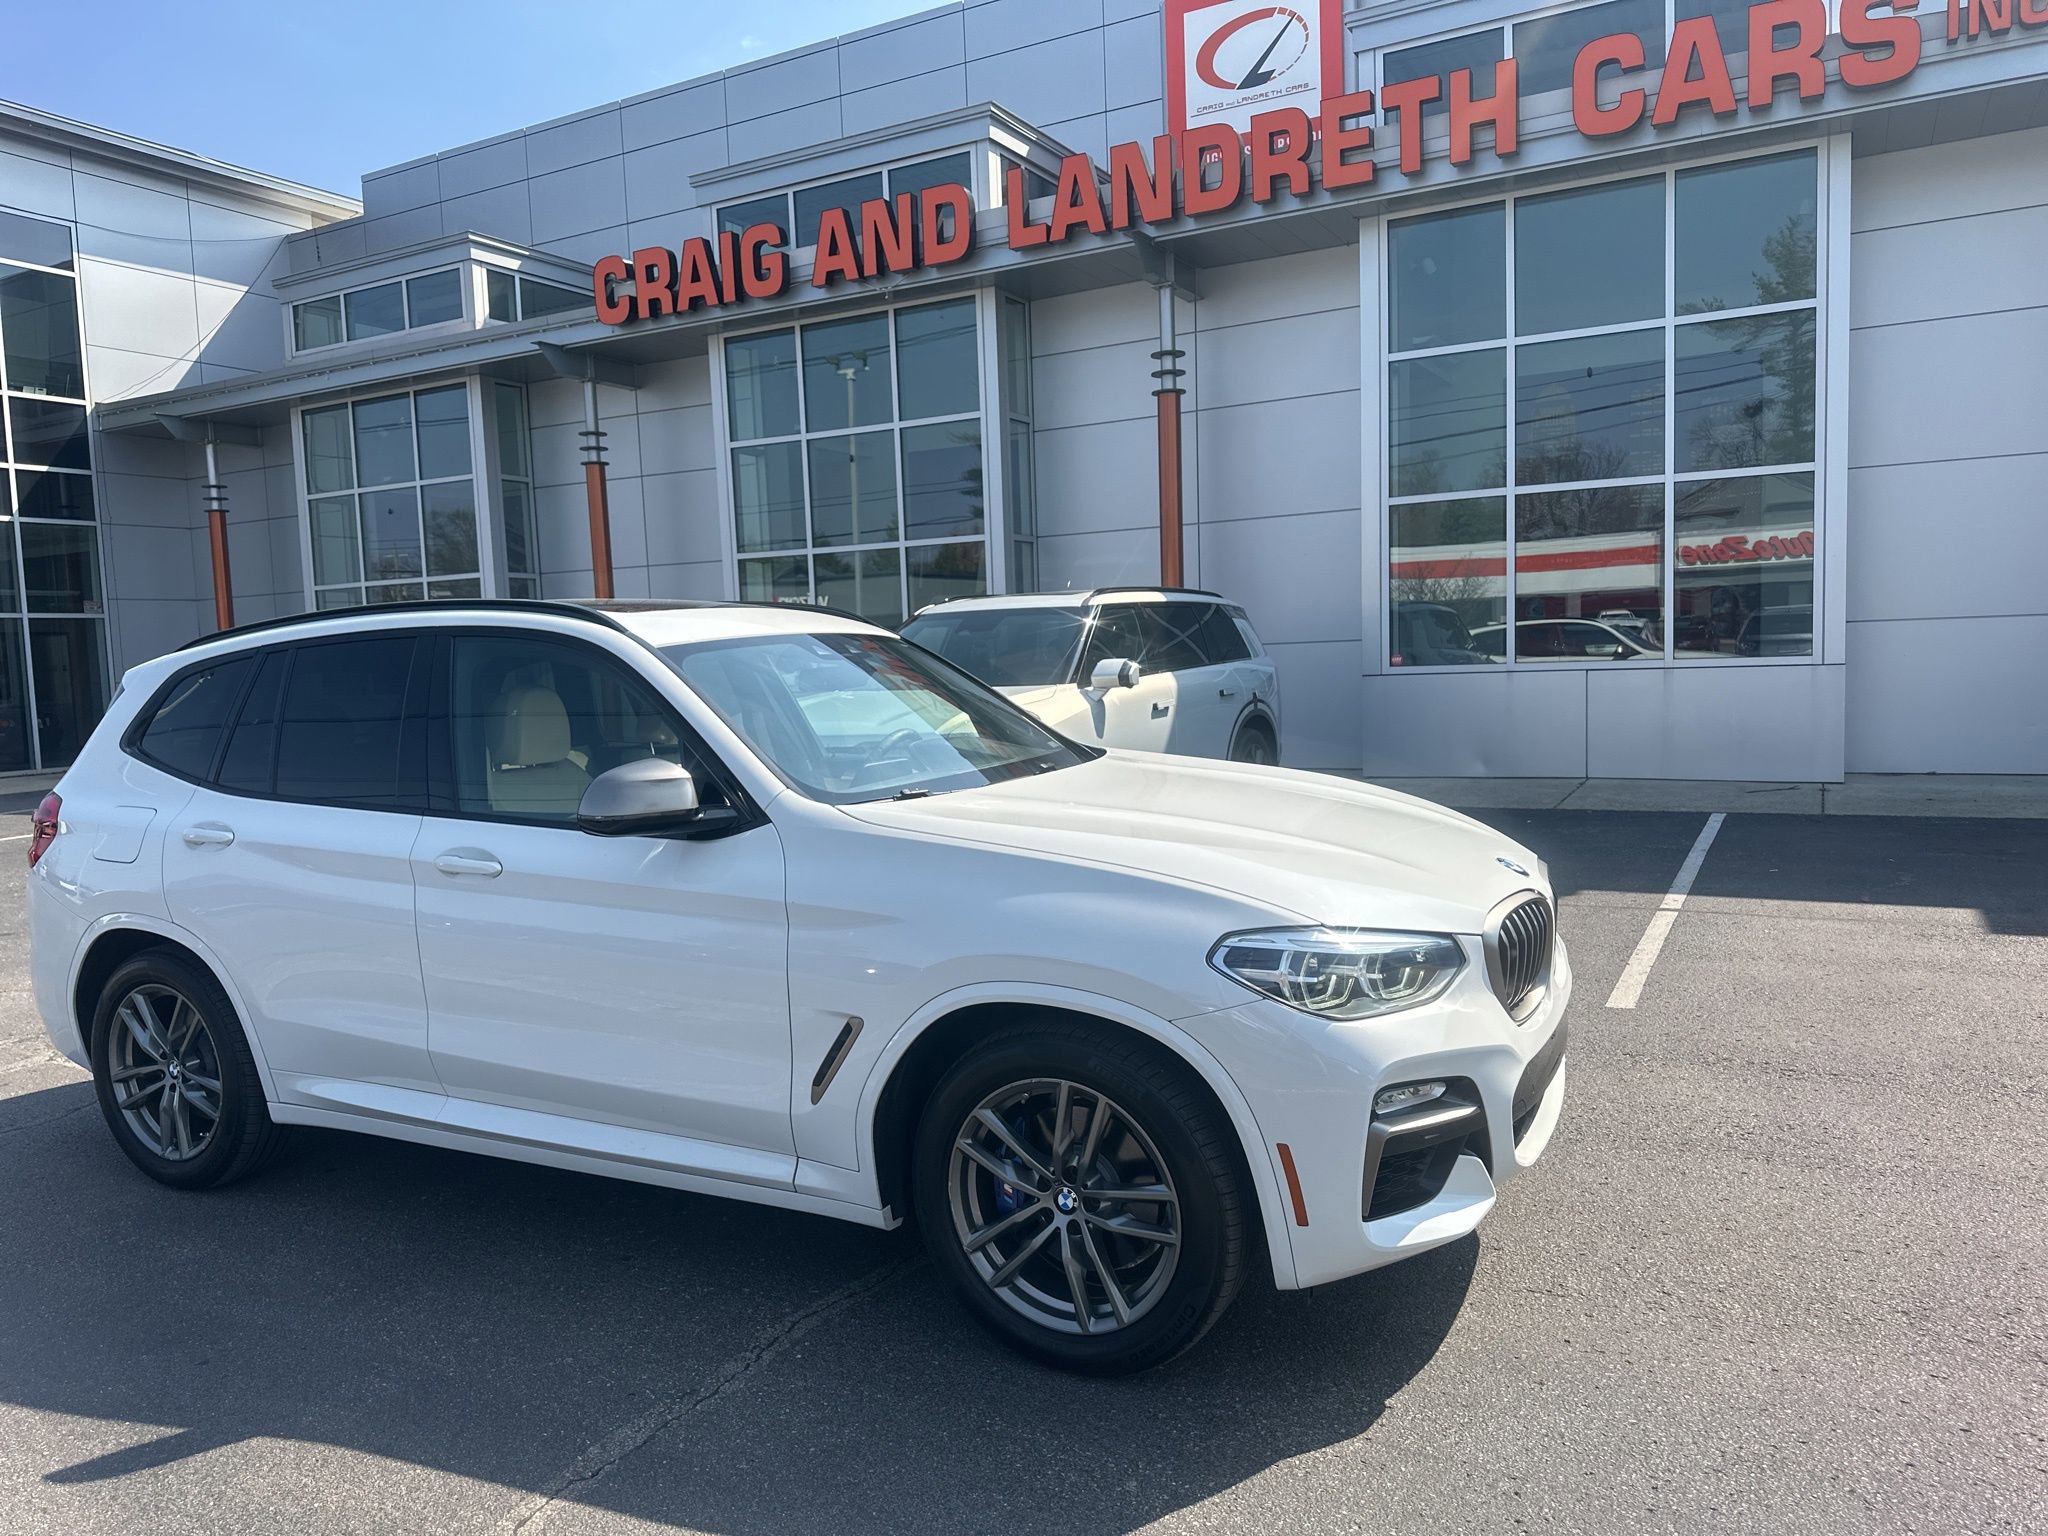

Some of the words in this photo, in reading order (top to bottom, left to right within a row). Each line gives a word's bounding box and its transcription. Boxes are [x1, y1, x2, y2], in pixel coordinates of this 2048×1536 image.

[593, 223, 790, 326] CRAIG
[812, 183, 975, 288] AND
[1007, 57, 1518, 251] LANDRETH
[1572, 0, 1922, 137] CARS
[1196, 102, 1224, 113] CRAIG
[1236, 90, 1283, 104] LANDRETH
[1285, 82, 1310, 93] CARS
